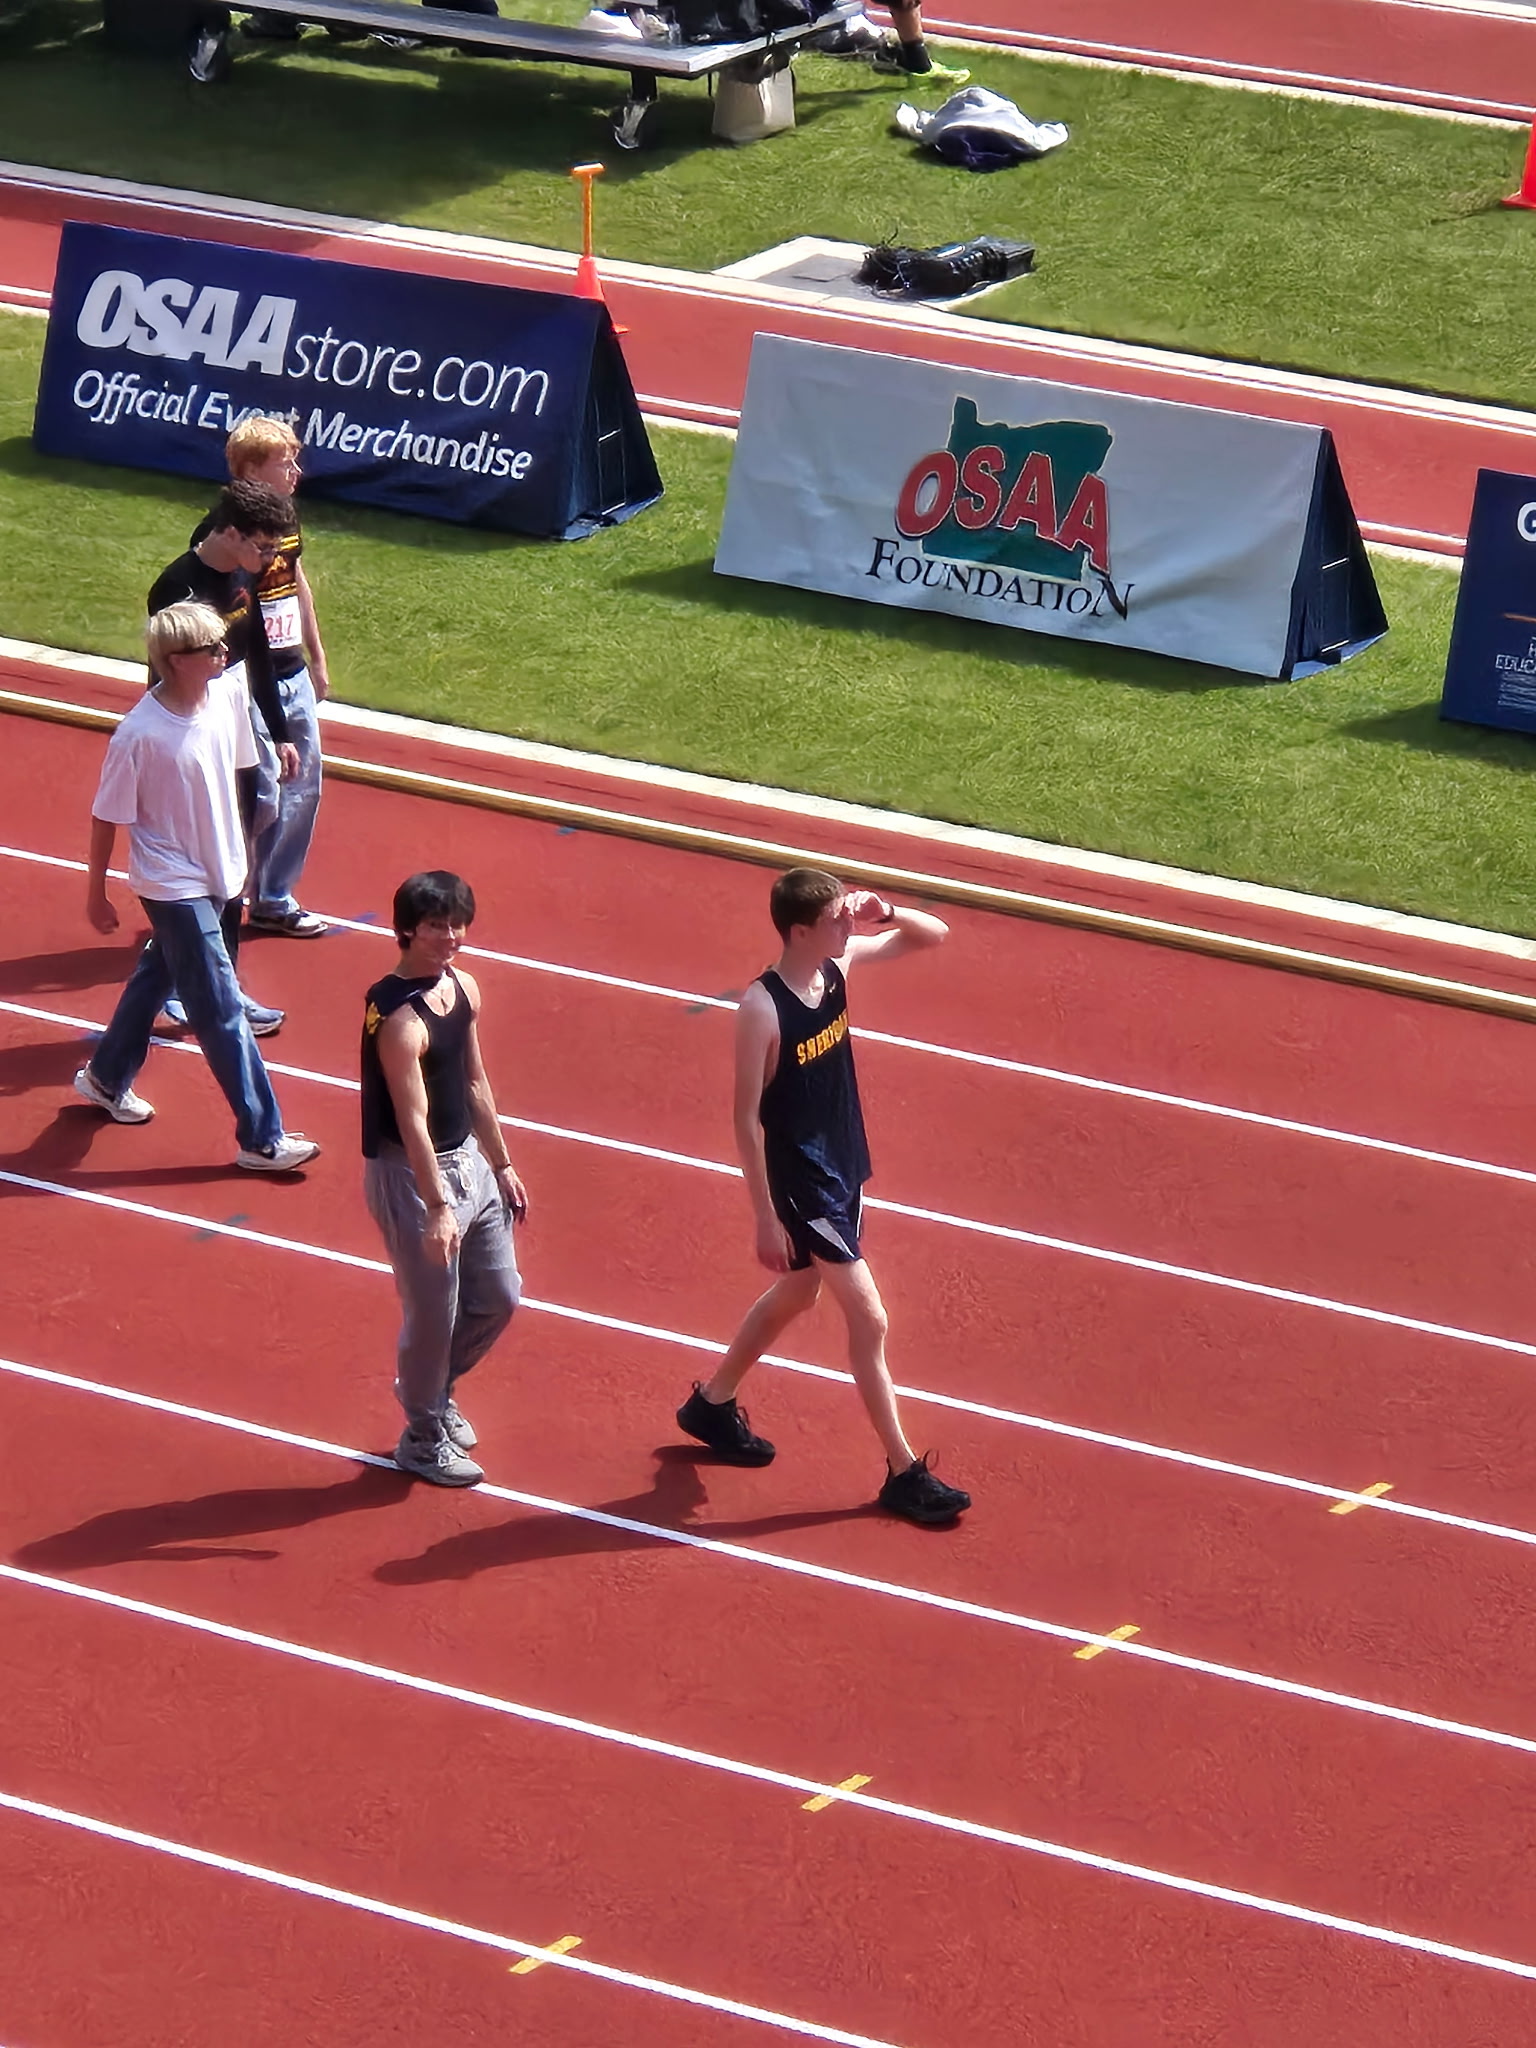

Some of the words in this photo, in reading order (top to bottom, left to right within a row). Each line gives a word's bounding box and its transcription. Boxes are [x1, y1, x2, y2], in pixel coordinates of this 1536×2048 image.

[73, 369, 198, 425] Official
[303, 407, 534, 480] Merchandise
[895, 445, 1111, 576] OSAA
[865, 536, 1134, 621] FOUNDATION
